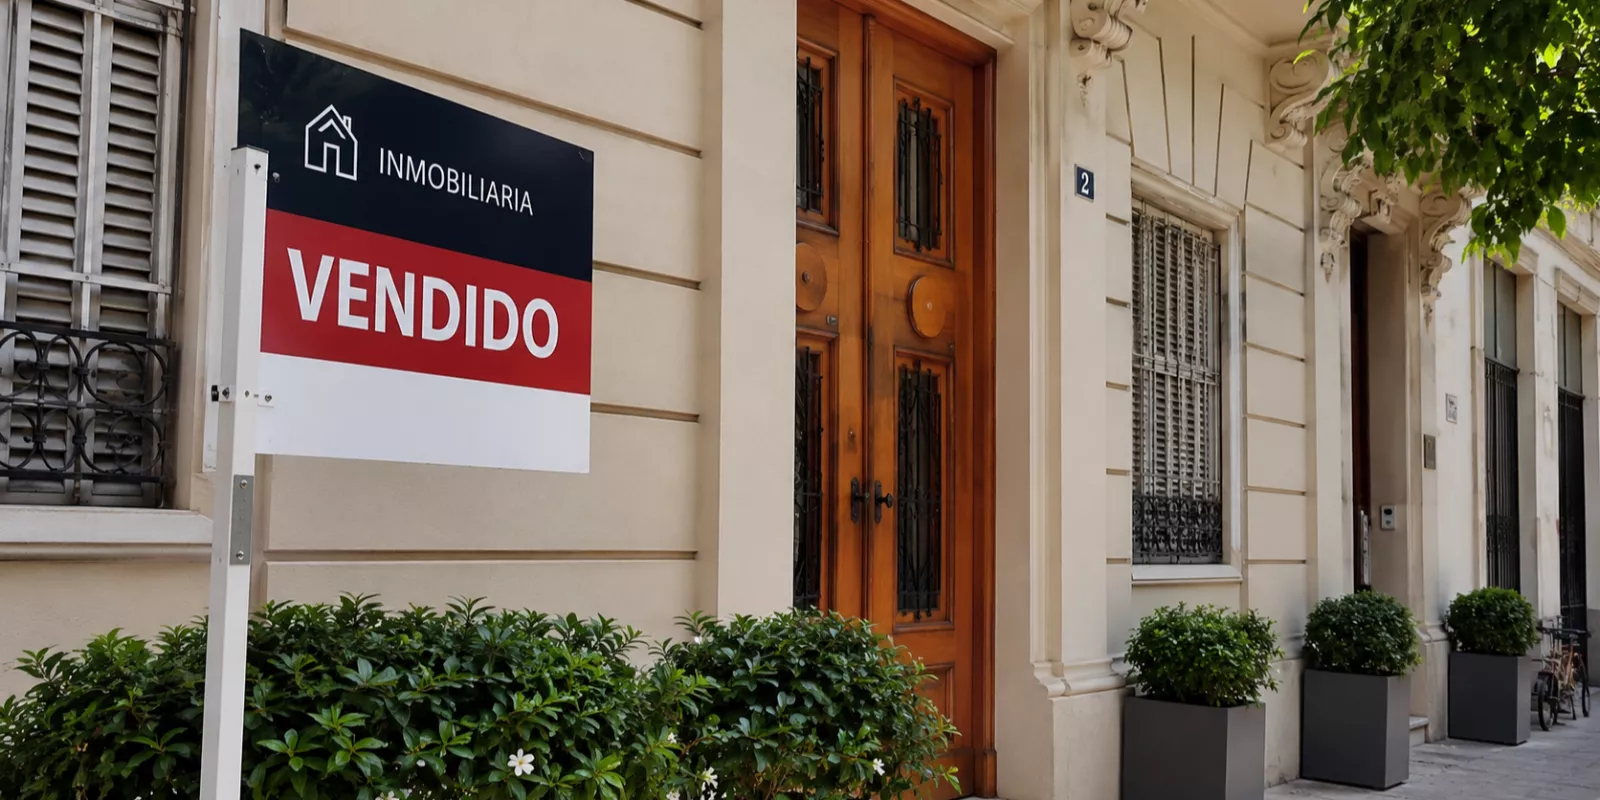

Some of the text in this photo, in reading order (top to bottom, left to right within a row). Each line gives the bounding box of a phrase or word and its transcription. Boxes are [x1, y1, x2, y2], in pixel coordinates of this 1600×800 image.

[380, 148, 533, 216] INMOBILIARIA
[1081, 171, 1089, 195] 2
[287, 248, 559, 359] VENDIDO
